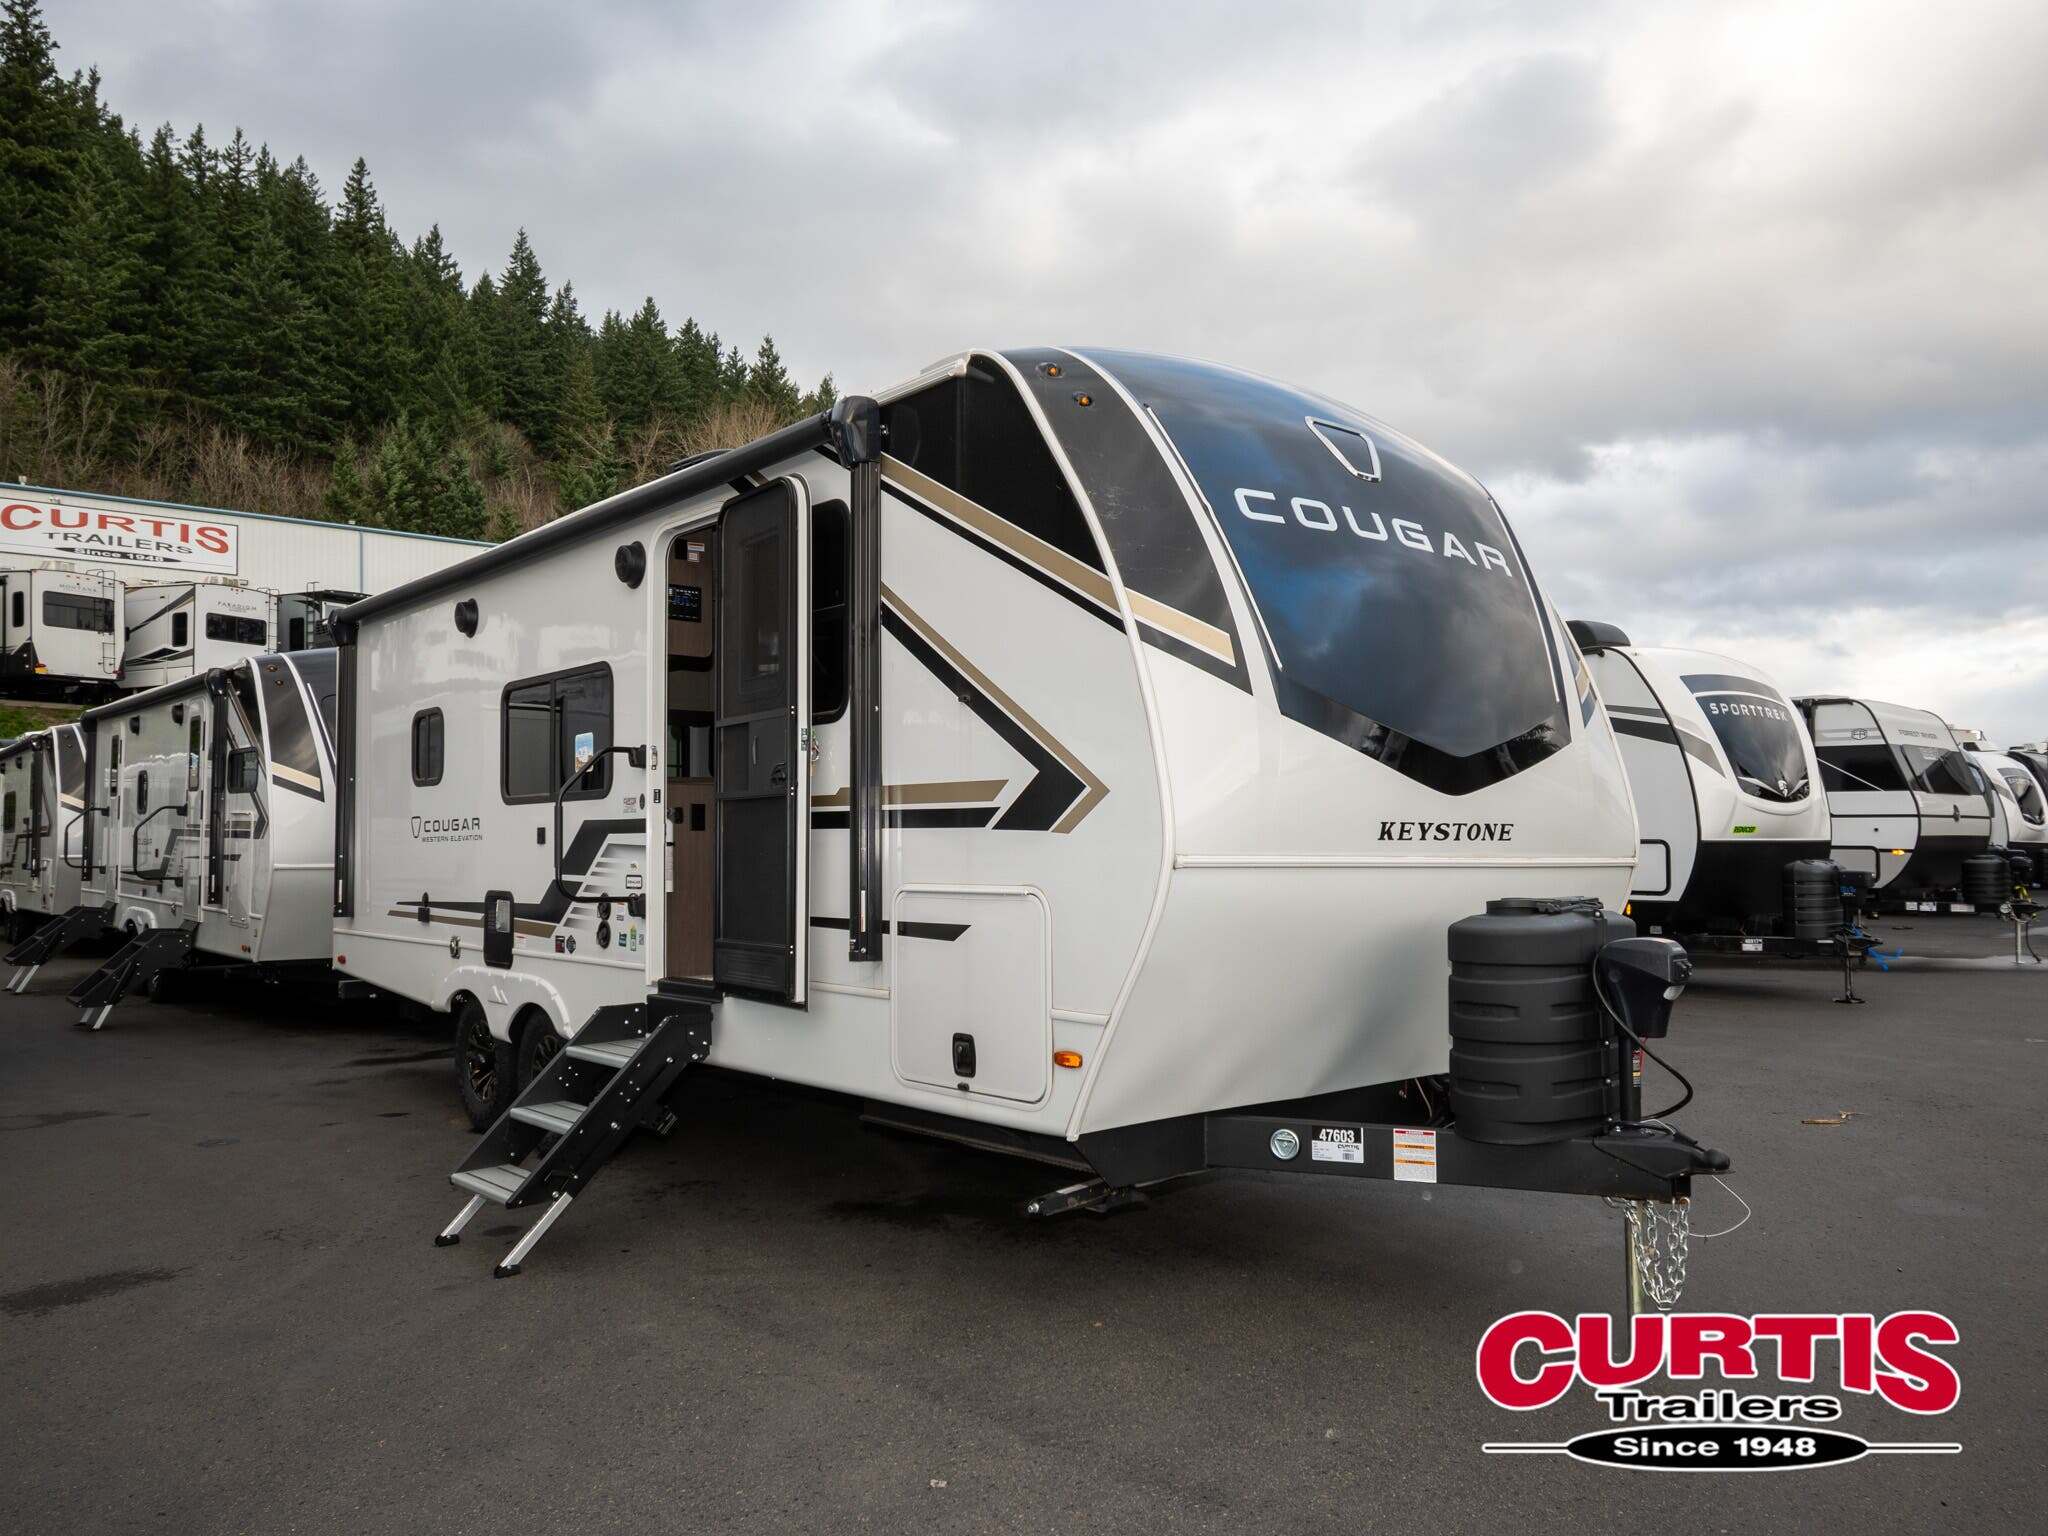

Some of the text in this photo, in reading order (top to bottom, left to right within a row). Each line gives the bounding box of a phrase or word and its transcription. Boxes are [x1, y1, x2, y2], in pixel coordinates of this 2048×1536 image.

[1, 504, 229, 554] CURTIS
[1234, 487, 1512, 577] COUGAR
[42, 532, 193, 555] TRAILERS
[75, 547, 165, 563] Since 1948
[1710, 702, 1789, 721] SPORTTREK
[423, 817, 480, 832] COUGAR
[1377, 822, 1514, 841] KEYSTONE
[450, 834, 482, 842] ELEVATION
[1319, 1128, 1355, 1144] 47603
